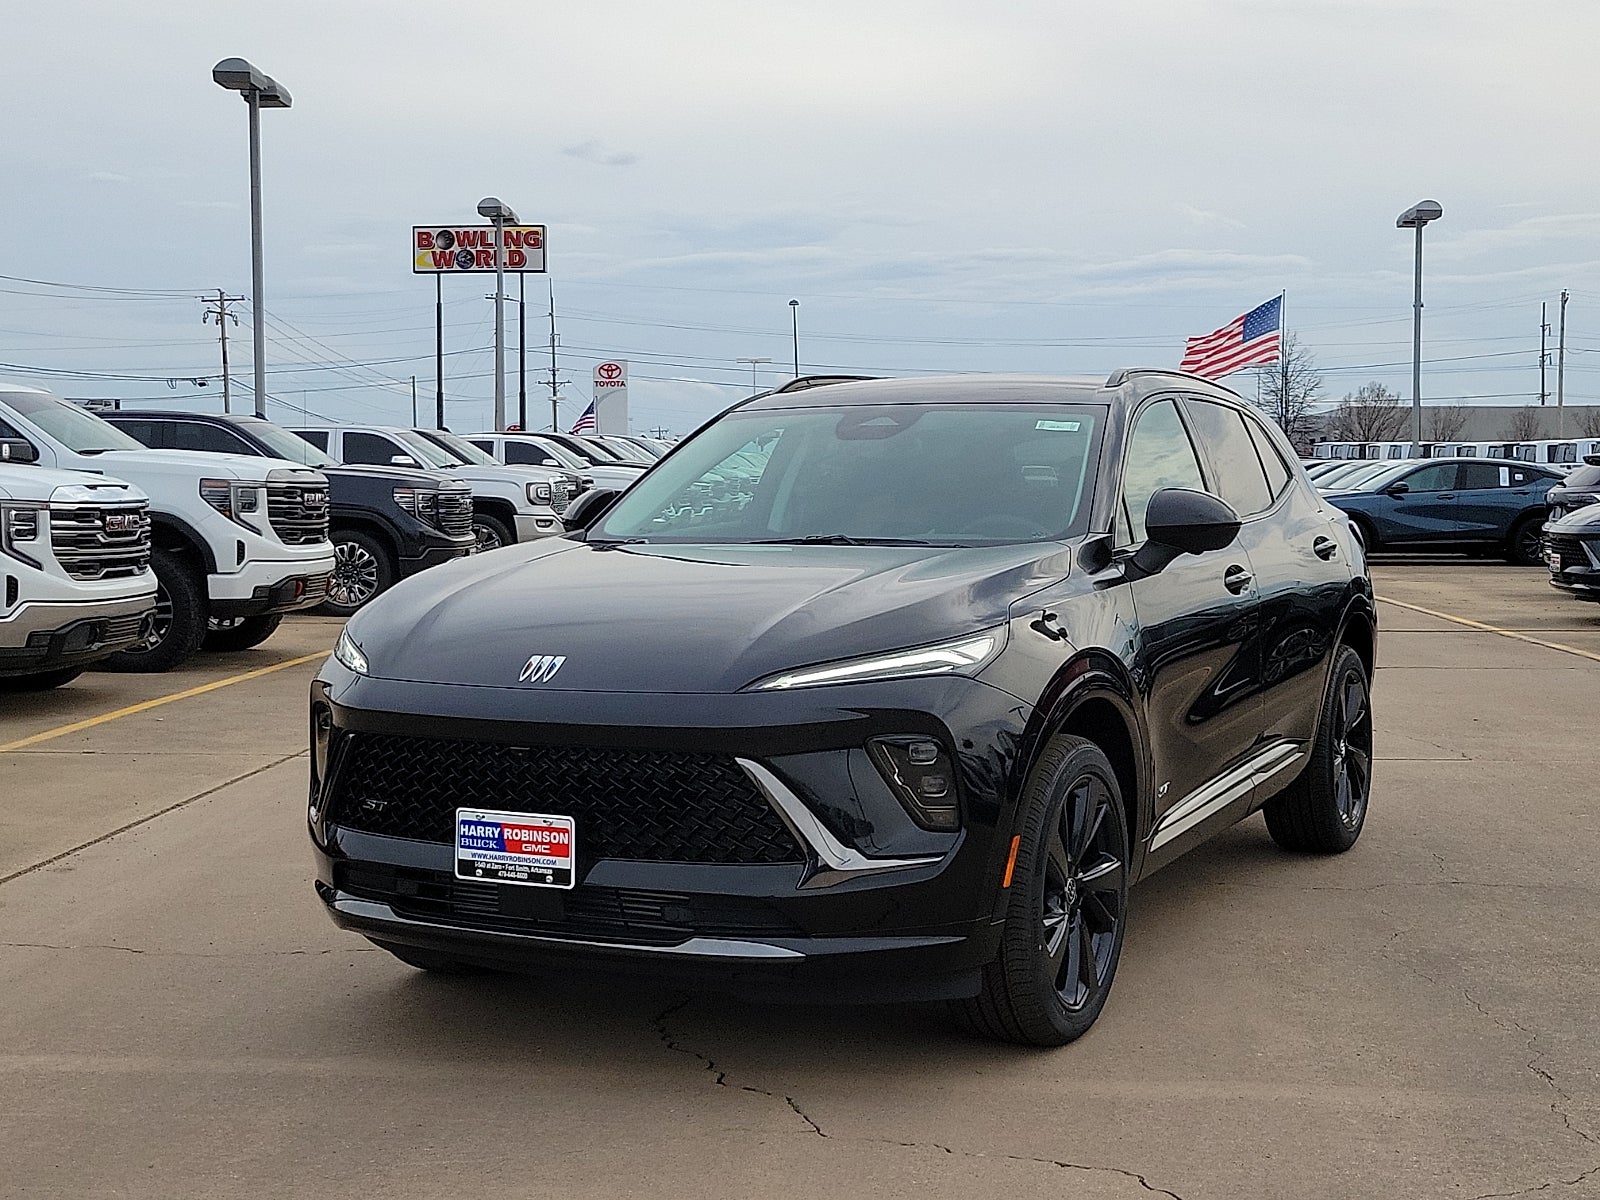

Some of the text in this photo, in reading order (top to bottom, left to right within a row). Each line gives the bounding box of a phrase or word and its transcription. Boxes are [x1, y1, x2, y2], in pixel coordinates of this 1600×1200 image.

[417, 230, 542, 250] BOWLNG
[594, 380, 626, 388] TOYOTA
[106, 514, 140, 531] GMC
[362, 798, 388, 811] ST
[460, 824, 569, 845] HARRY ROBINSON
[460, 837, 498, 849] BUICK
[522, 843, 551, 853] GMC
[530, 866, 553, 875] Arkansas
